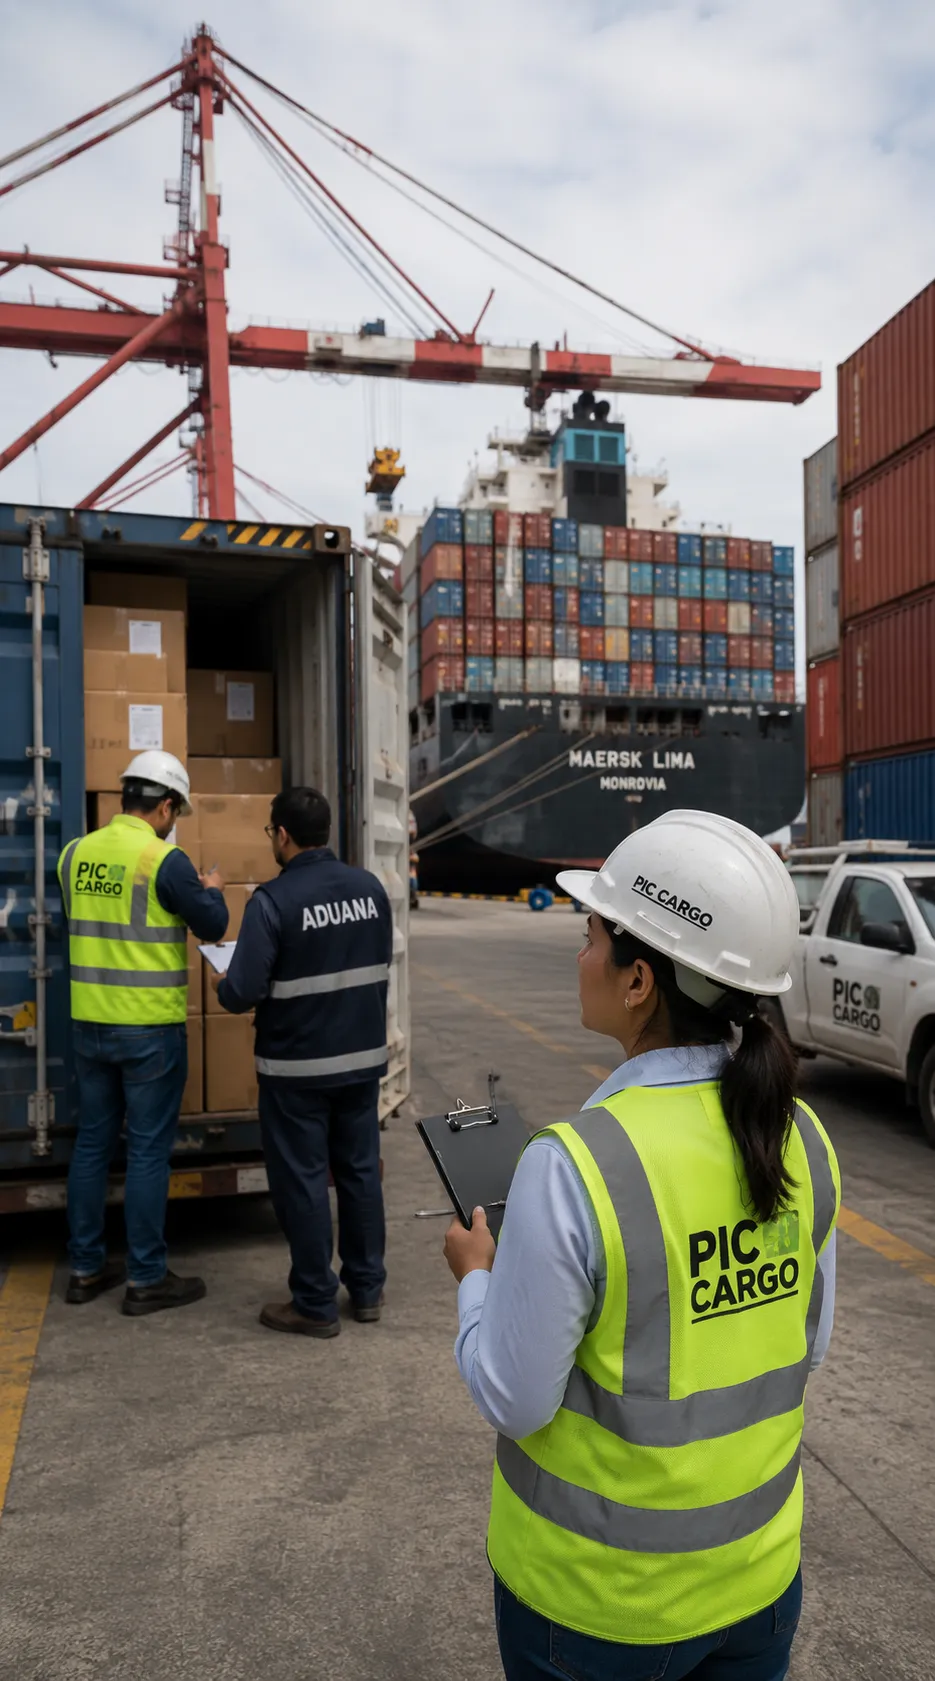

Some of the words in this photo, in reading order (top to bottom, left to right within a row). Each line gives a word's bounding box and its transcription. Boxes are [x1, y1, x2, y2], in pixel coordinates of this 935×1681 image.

[569, 750, 642, 768] MAERSK
[653, 751, 695, 769] LIMA
[600, 776, 667, 790] MONROVIA
[77, 862, 107, 879] PIC
[75, 880, 122, 895] CARGO
[633, 875, 657, 896] PIC
[657, 889, 713, 927] CARGO
[302, 897, 379, 931] ADUANA
[833, 977, 862, 1006] PIC
[833, 1004, 880, 1031] CARGO
[688, 1219, 760, 1279] PIC
[691, 1257, 799, 1314] CARGO
